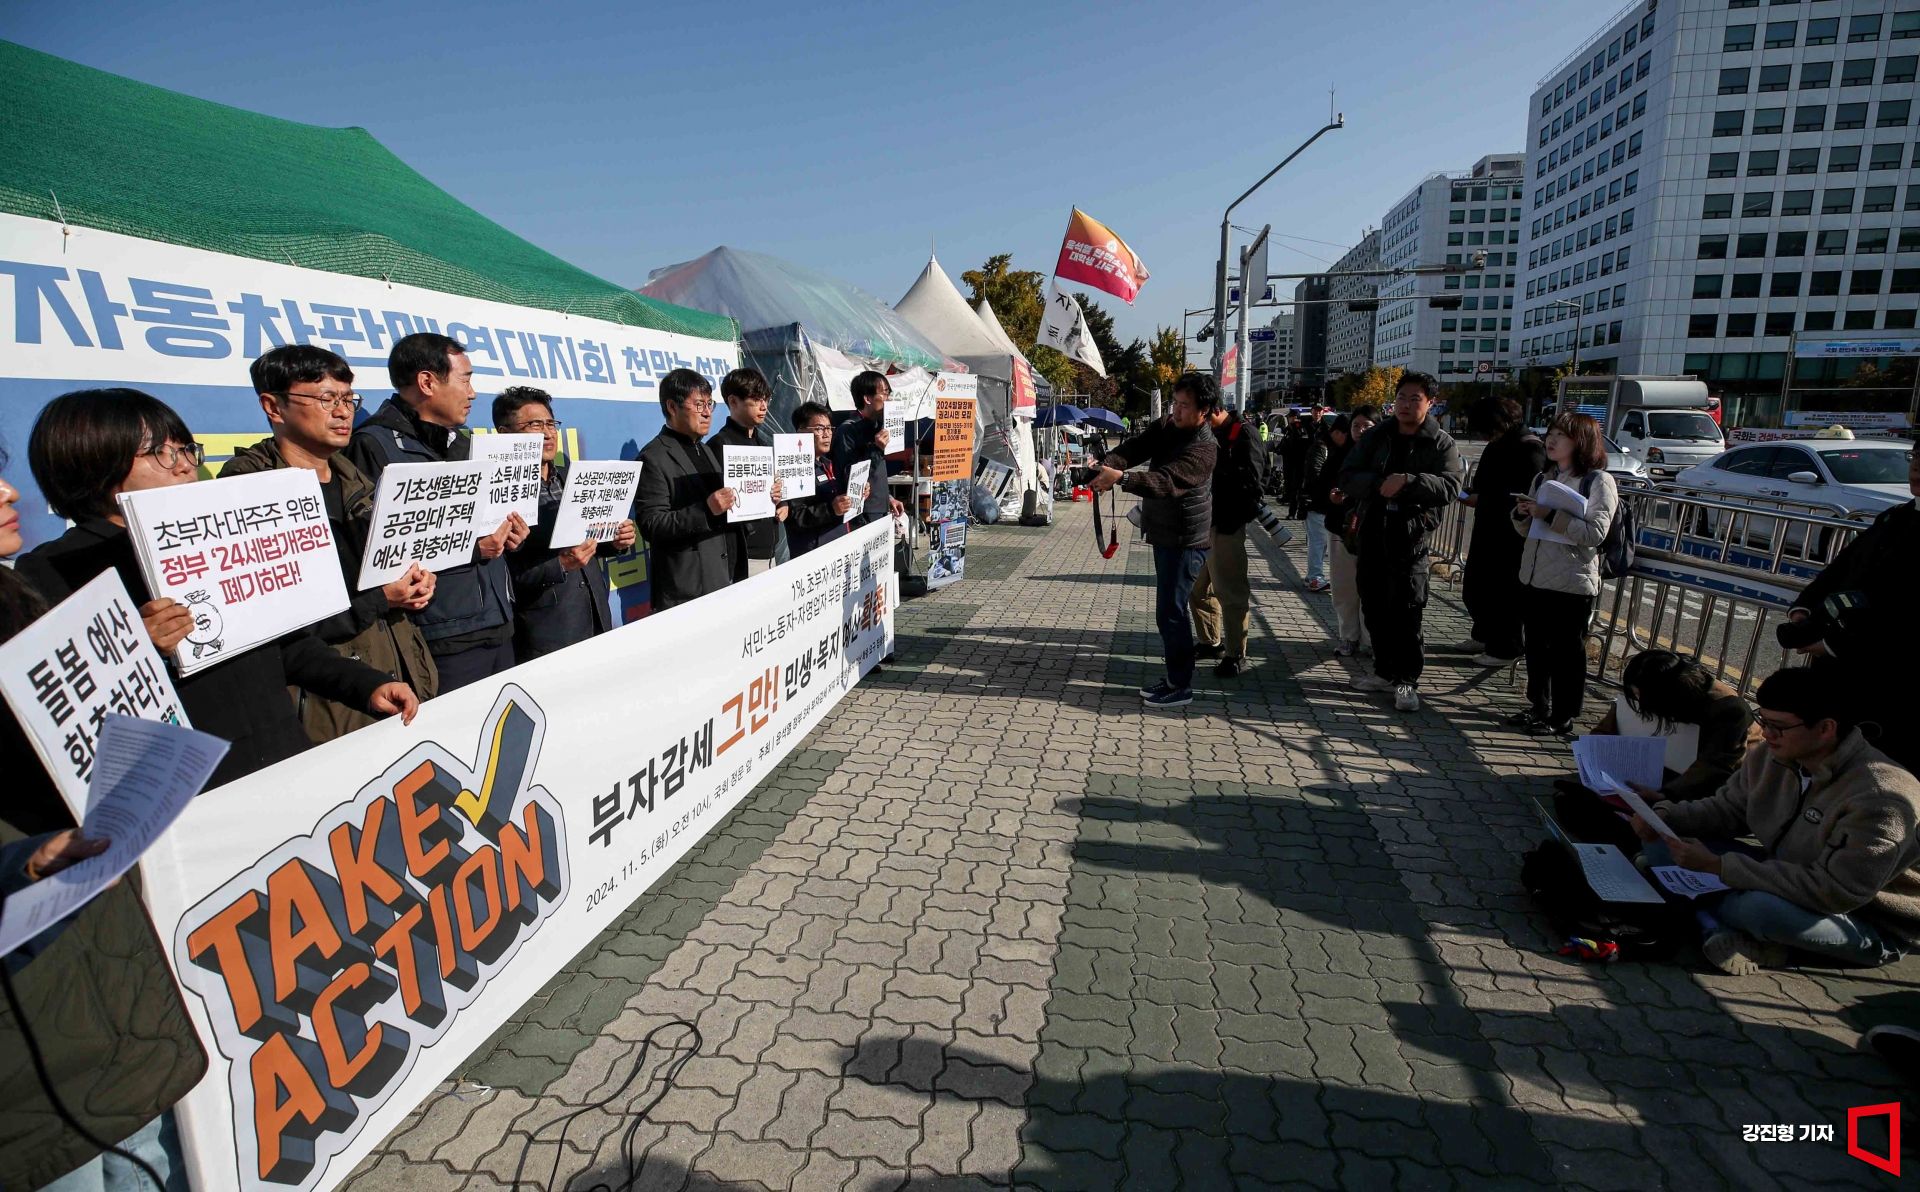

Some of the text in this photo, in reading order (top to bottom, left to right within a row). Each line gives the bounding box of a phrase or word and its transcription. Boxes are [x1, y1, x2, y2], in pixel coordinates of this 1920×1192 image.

[393, 472, 482, 504] 기초생활보장
[523, 464, 540, 481] 비중
[574, 471, 635, 485] 소상공인·자영업자
[728, 464, 772, 478] 금융투자소득세
[739, 480, 767, 494] 시행하라!
[490, 482, 539, 504] 10년 중 최대
[571, 488, 628, 503] 노동자 지원 예산
[581, 505, 613, 520] 확충하라!
[154, 495, 321, 551] 초부자·대주주 위한
[383, 505, 446, 539] 공공임대
[446, 501, 476, 526] 주택
[160, 551, 209, 587] 정부
[373, 530, 473, 570] 예산 확충하라!
[219, 560, 303, 605] 폐기하라!
[791, 579, 805, 600] 1%
[806, 565, 829, 594] 초부자
[829, 558, 843, 586] 세금
[742, 593, 827, 659] 서민·노동자·자영업자
[827, 582, 841, 608] 부담
[27, 599, 139, 728] 돌봄 예산
[589, 717, 713, 848] 부자감세
[717, 665, 779, 757] 그만!
[785, 625, 840, 701] 민생·복지
[586, 876, 618, 913] 2024.
[622, 861, 638, 881] 11.
[671, 813, 690, 839] 오전
[692, 795, 712, 820] 10시,
[714, 777, 729, 800] 국회
[730, 766, 744, 788] 정문
[745, 757, 753, 773] 앞
[759, 740, 771, 760] 주최
[187, 760, 462, 1042] TAKE
[250, 800, 560, 1184] ACTION
